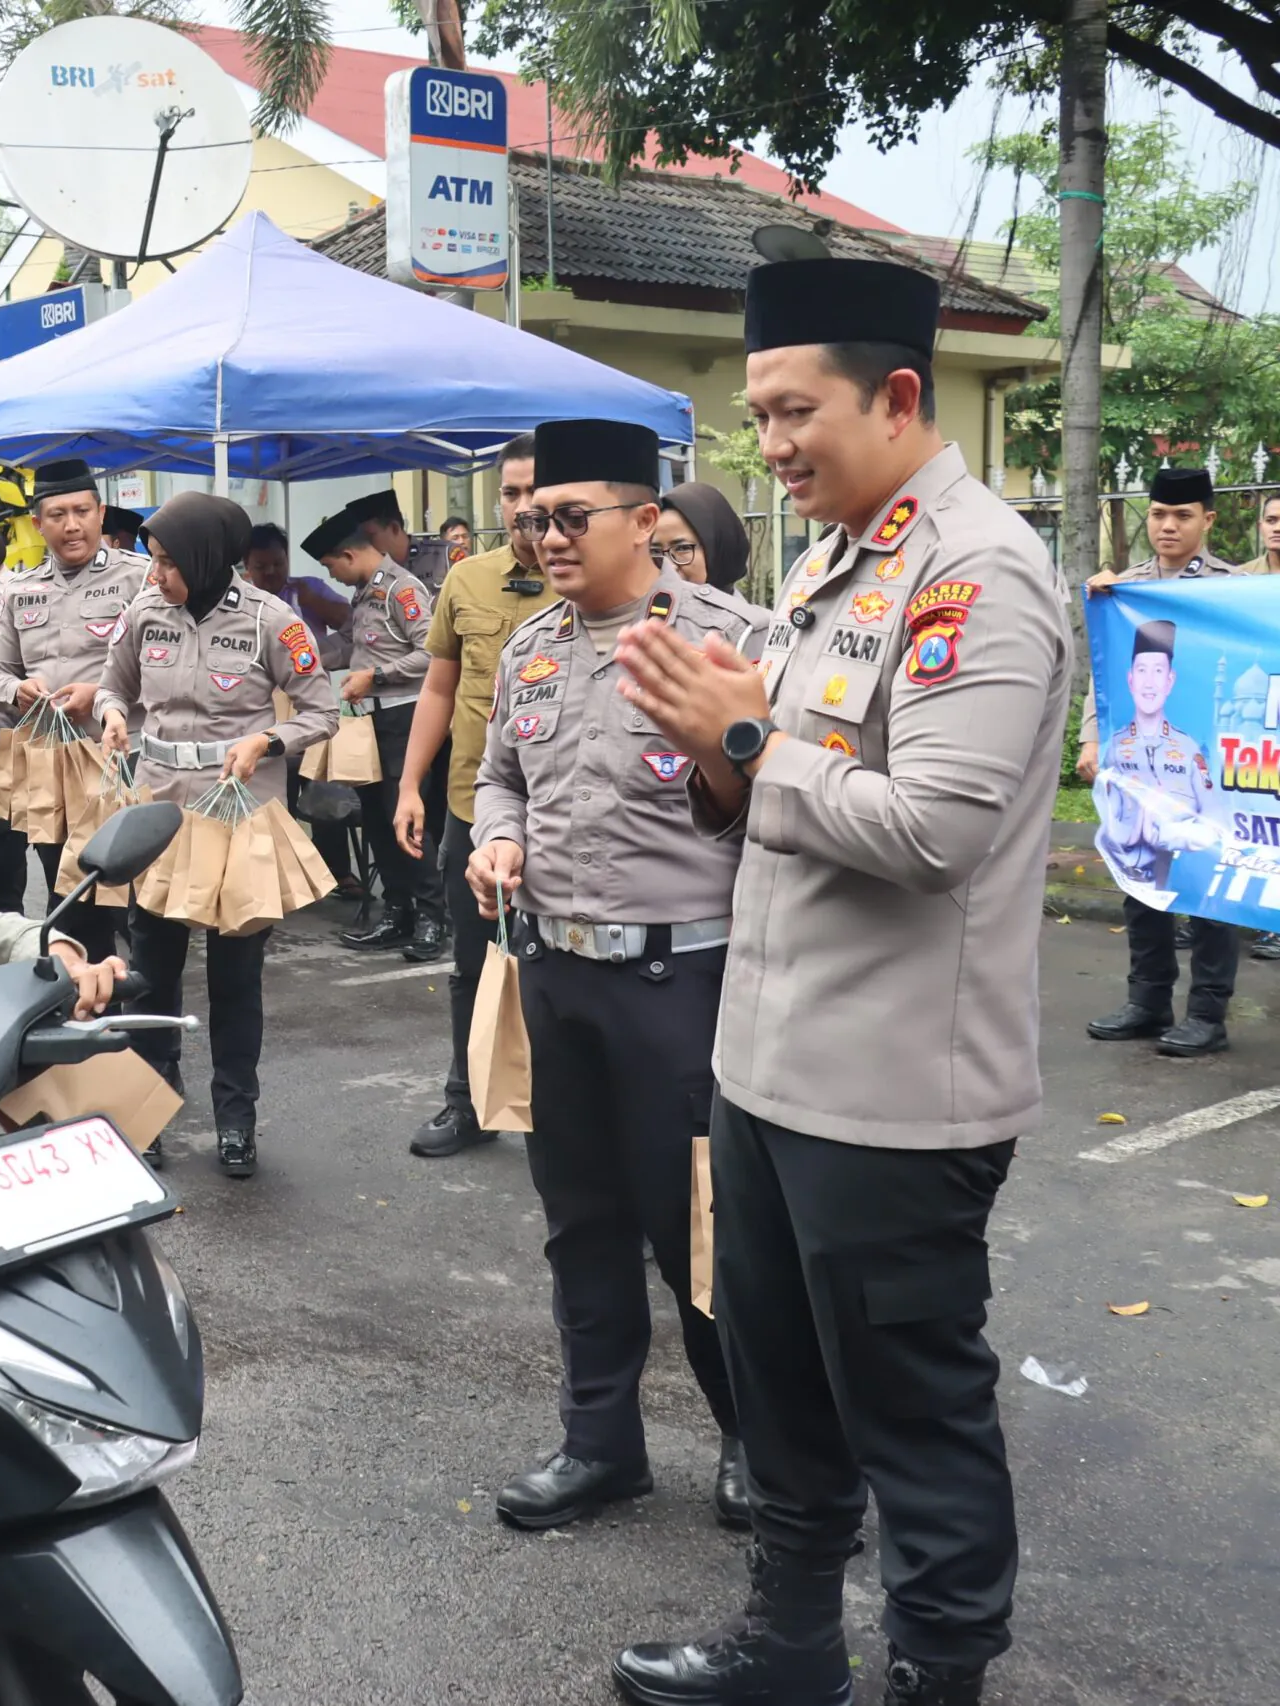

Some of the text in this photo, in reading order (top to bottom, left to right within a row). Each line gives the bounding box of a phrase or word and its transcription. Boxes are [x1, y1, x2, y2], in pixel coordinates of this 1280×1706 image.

[51, 65, 176, 88] BRI sat
[453, 85, 493, 121] BRI
[428, 174, 493, 206] ATM
[54, 300, 76, 325] BRI
[18, 594, 47, 607] DIMAS
[85, 586, 120, 600] POLRI
[145, 628, 181, 643] DIAN
[210, 635, 253, 652] POLRI
[768, 624, 797, 649] ERIK
[828, 629, 882, 663] POLRI
[515, 684, 558, 708] AZMI
[1164, 763, 1187, 775] POLRI
[79, 1128, 118, 1165] XY
